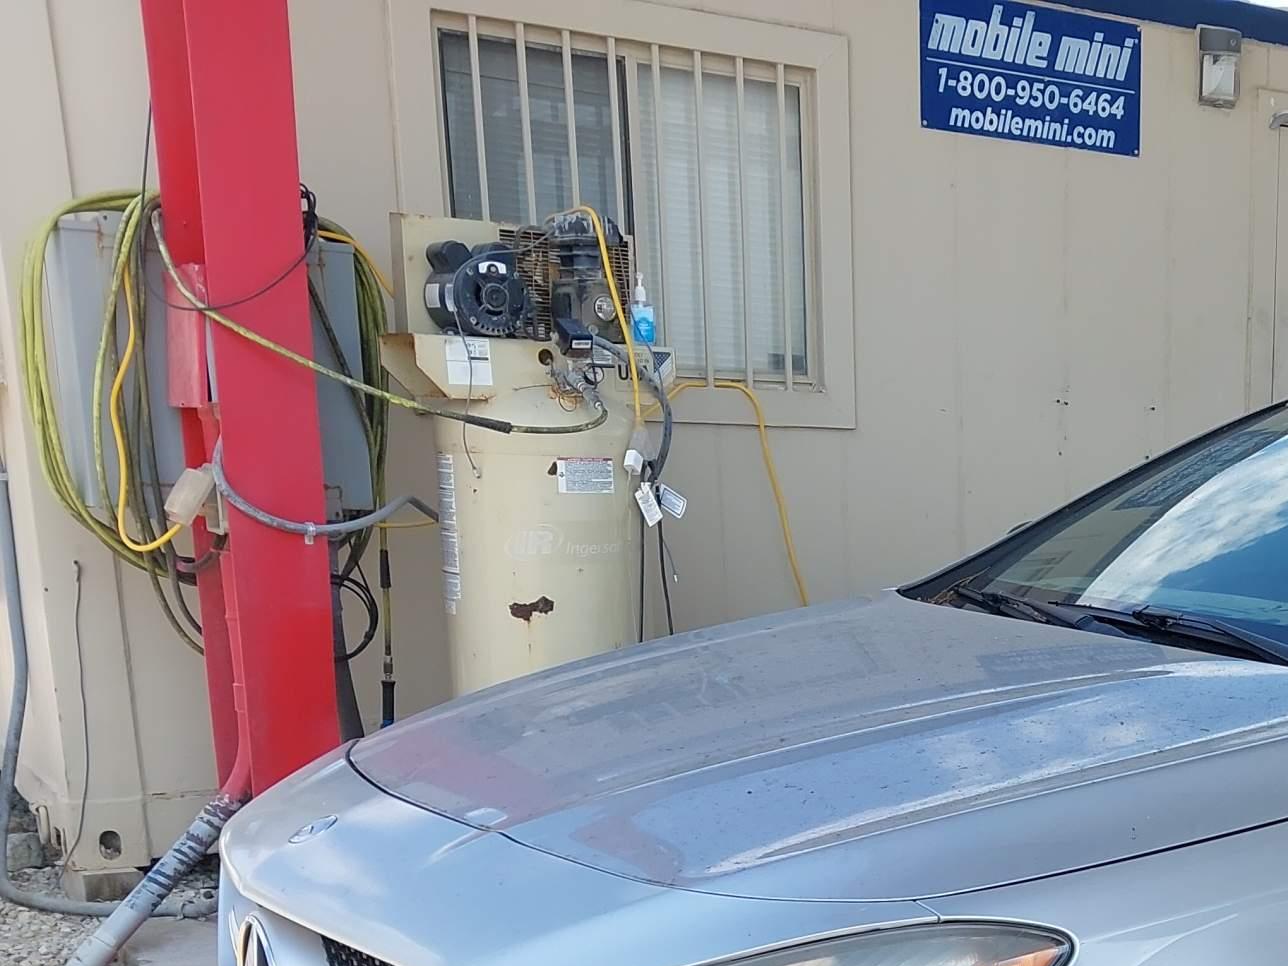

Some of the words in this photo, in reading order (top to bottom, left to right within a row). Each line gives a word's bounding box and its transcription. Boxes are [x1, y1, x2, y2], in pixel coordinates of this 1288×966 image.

[927, 4, 1052, 68] mobile
[1054, 32, 1134, 81] mini
[938, 67, 1125, 119] 1-800-950-6464
[949, 107, 1115, 148] mobilemini.com
